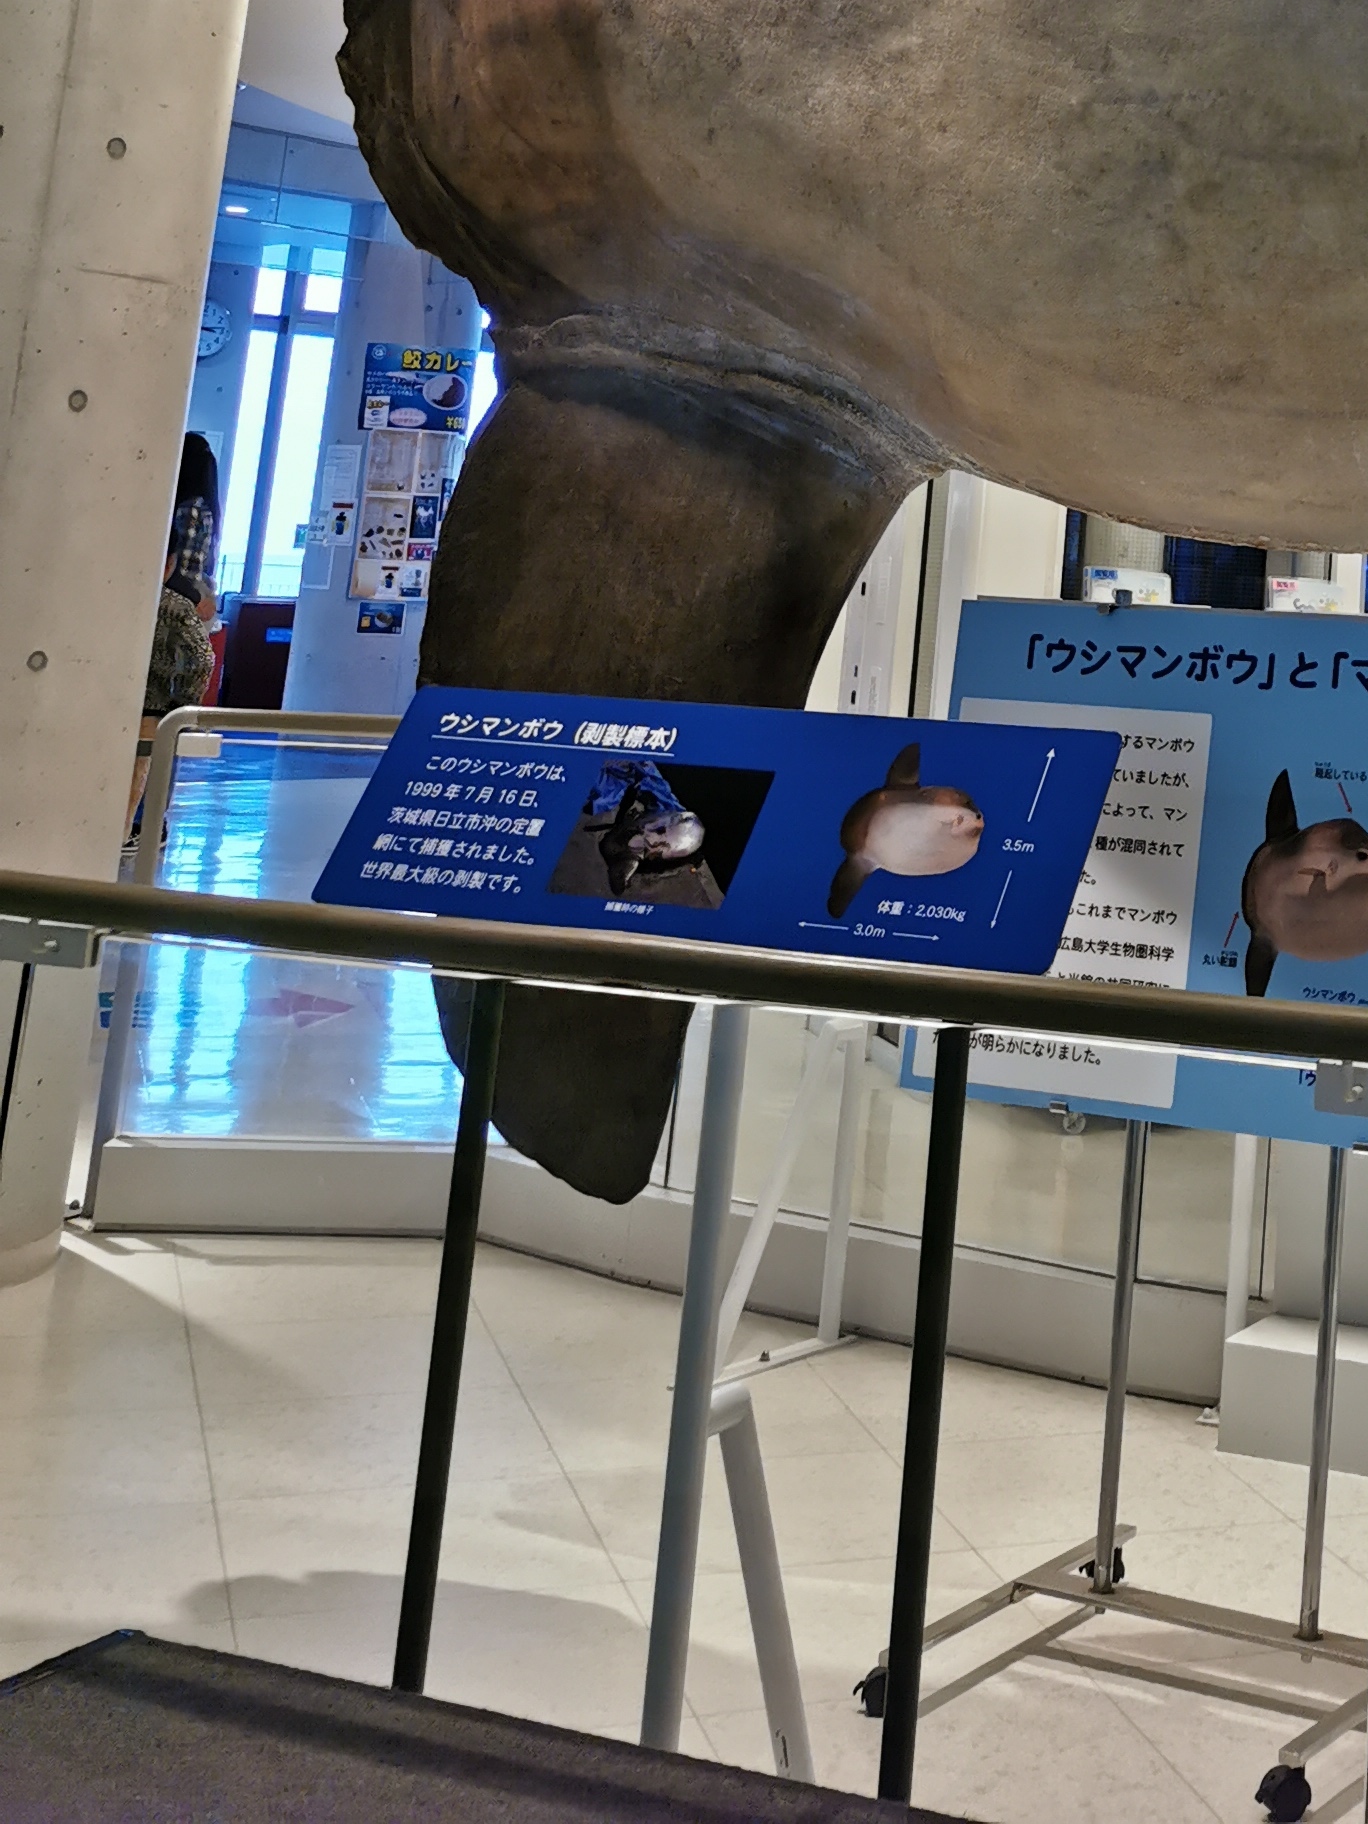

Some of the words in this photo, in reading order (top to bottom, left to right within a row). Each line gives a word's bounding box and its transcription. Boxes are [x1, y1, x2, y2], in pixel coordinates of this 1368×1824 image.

[440, 712, 564, 741] ウシマンボウ
[426, 756, 566, 782] このウシマンボウは、
[1002, 838, 1035, 854] 3.5m
[853, 923, 886, 938] 3.0m
[1302, 986, 1356, 1004] ウシマンボウ
